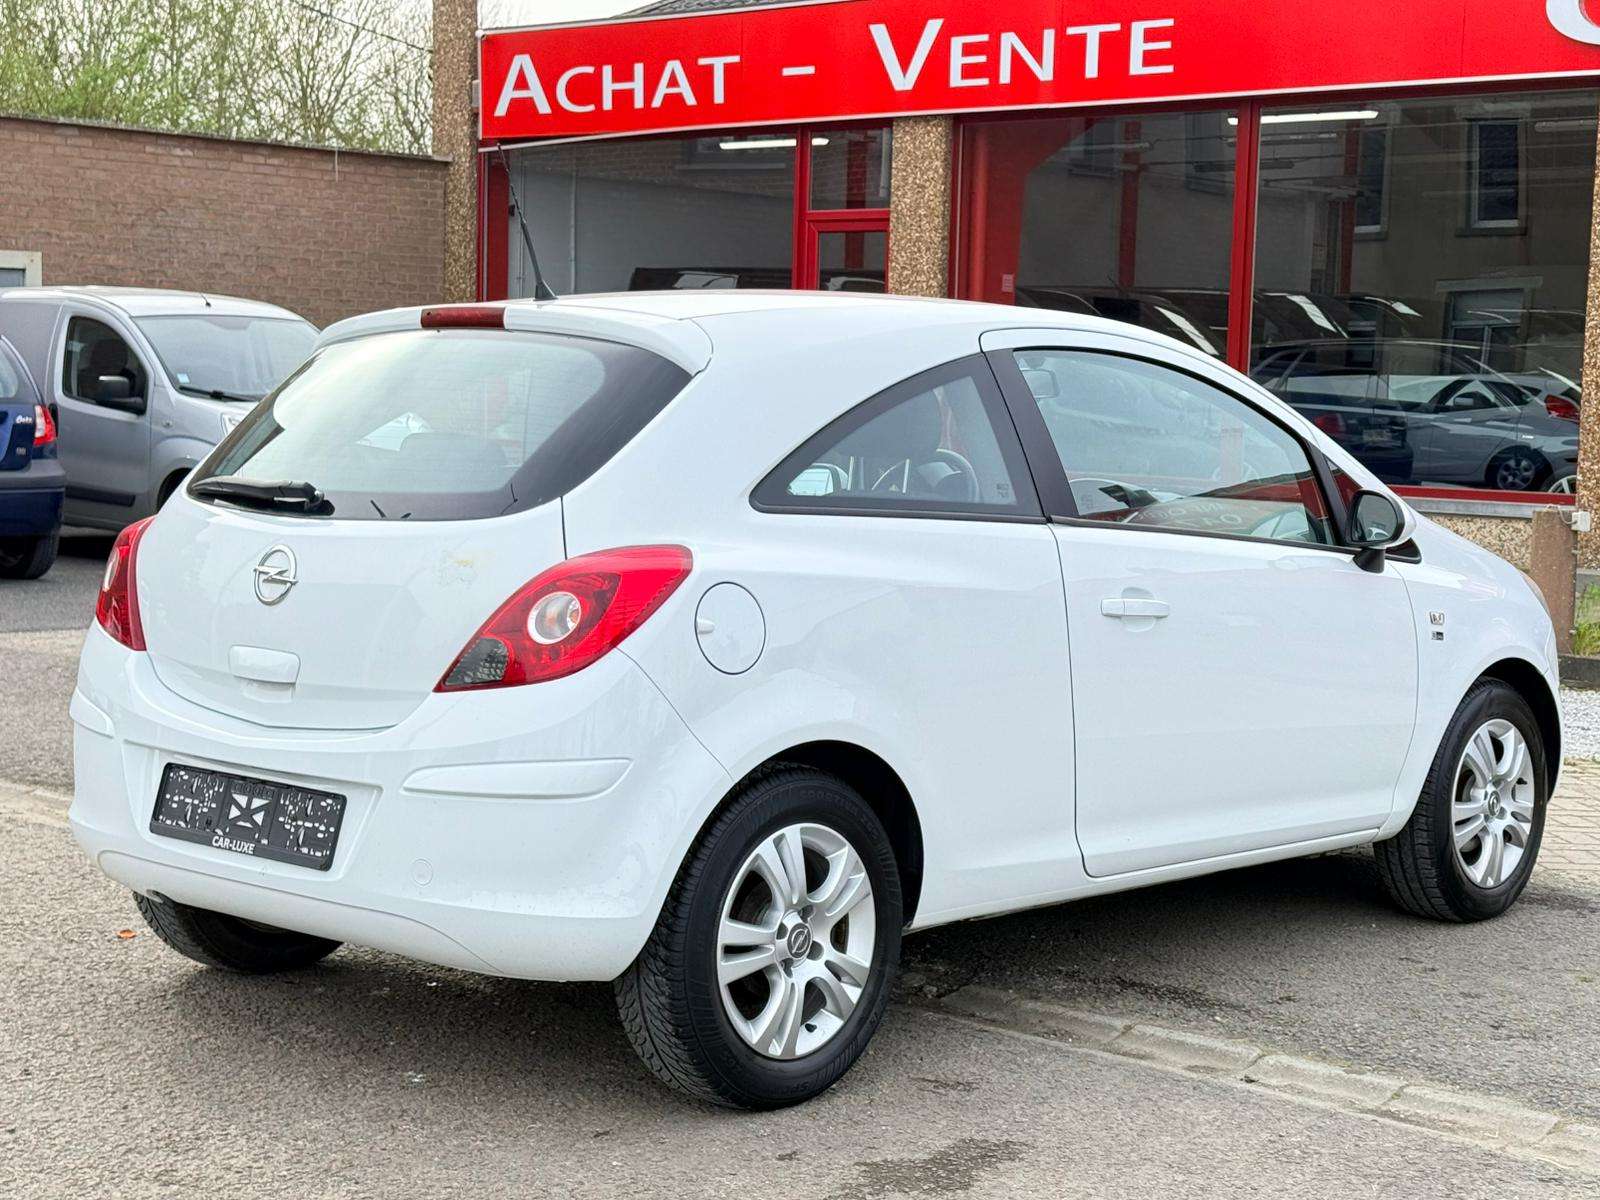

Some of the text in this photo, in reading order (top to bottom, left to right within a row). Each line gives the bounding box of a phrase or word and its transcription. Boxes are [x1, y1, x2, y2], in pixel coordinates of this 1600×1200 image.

[494, 18, 1175, 116] ACHAT - VENTE
[212, 836, 255, 854] CAR-LUXE
